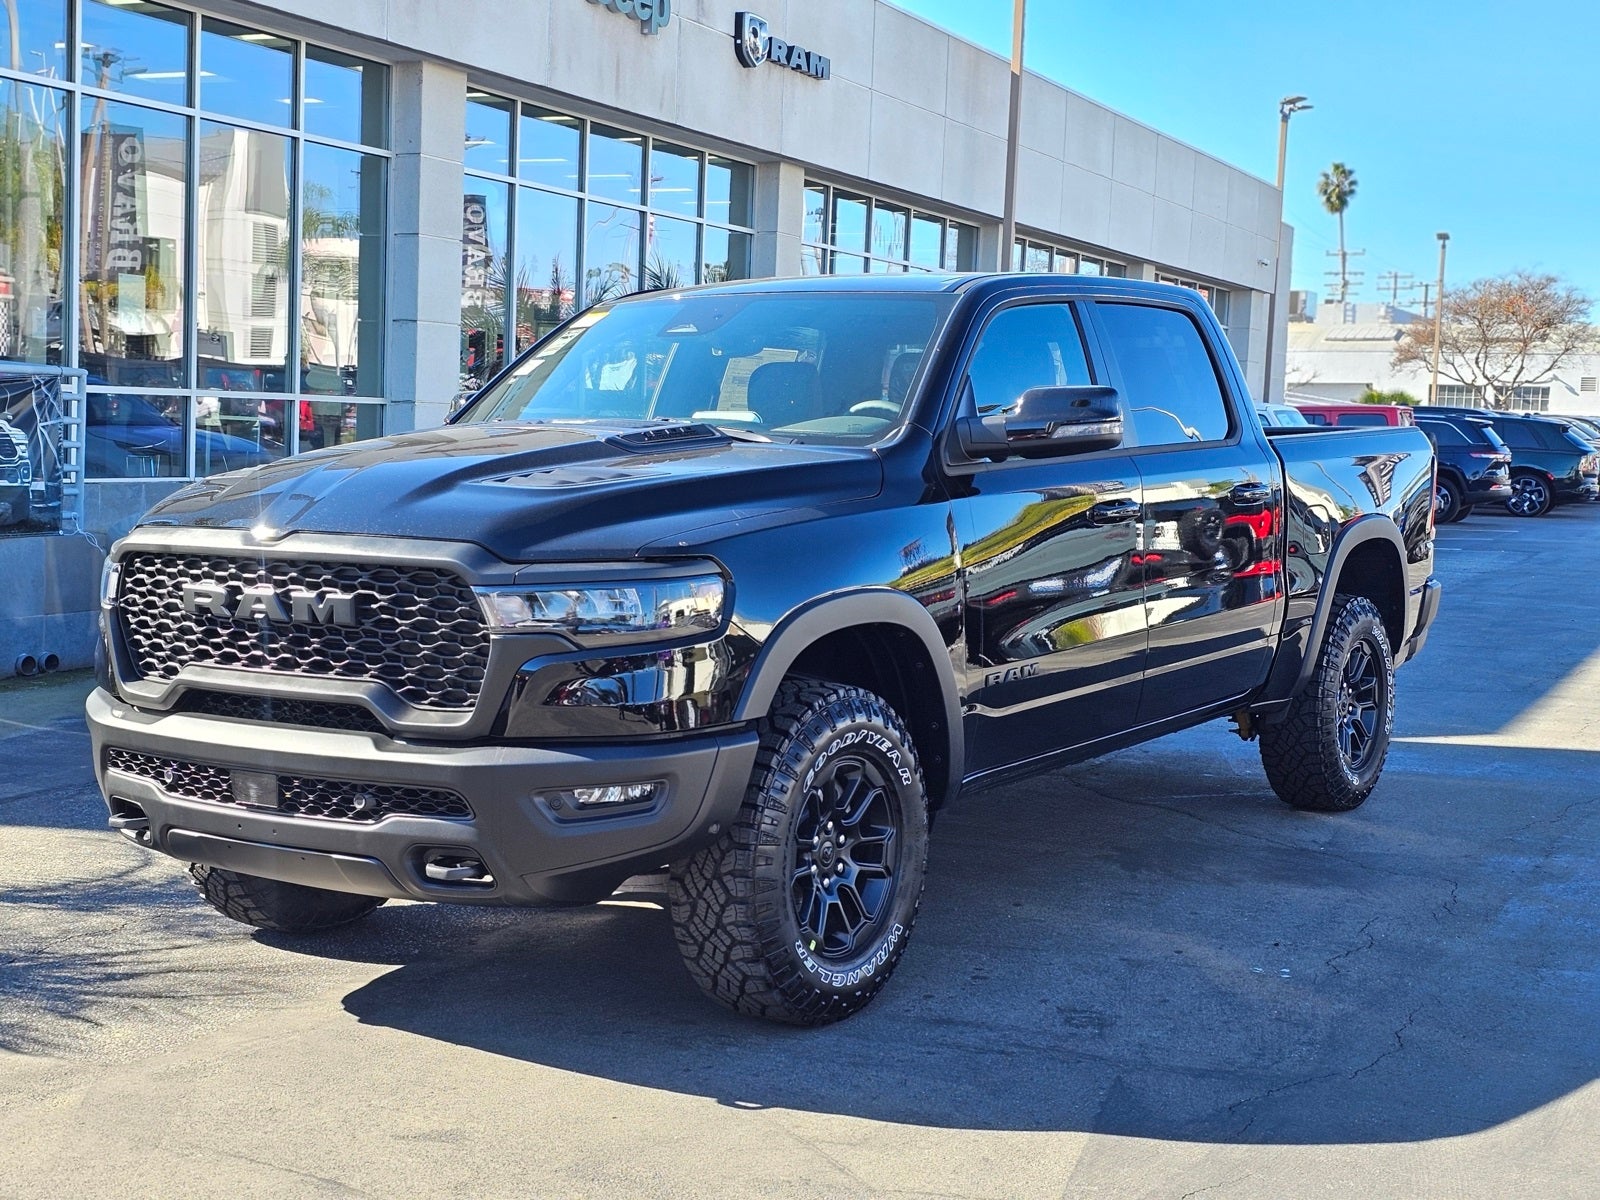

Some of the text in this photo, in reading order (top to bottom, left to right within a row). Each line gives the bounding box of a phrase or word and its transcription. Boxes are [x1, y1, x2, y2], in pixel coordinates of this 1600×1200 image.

[767, 37, 830, 80] RAM
[182, 583, 356, 626] RAM
[985, 662, 1040, 687] RAM
[802, 729, 912, 794] GOODYEAR
[795, 924, 903, 987] WRANGLER
